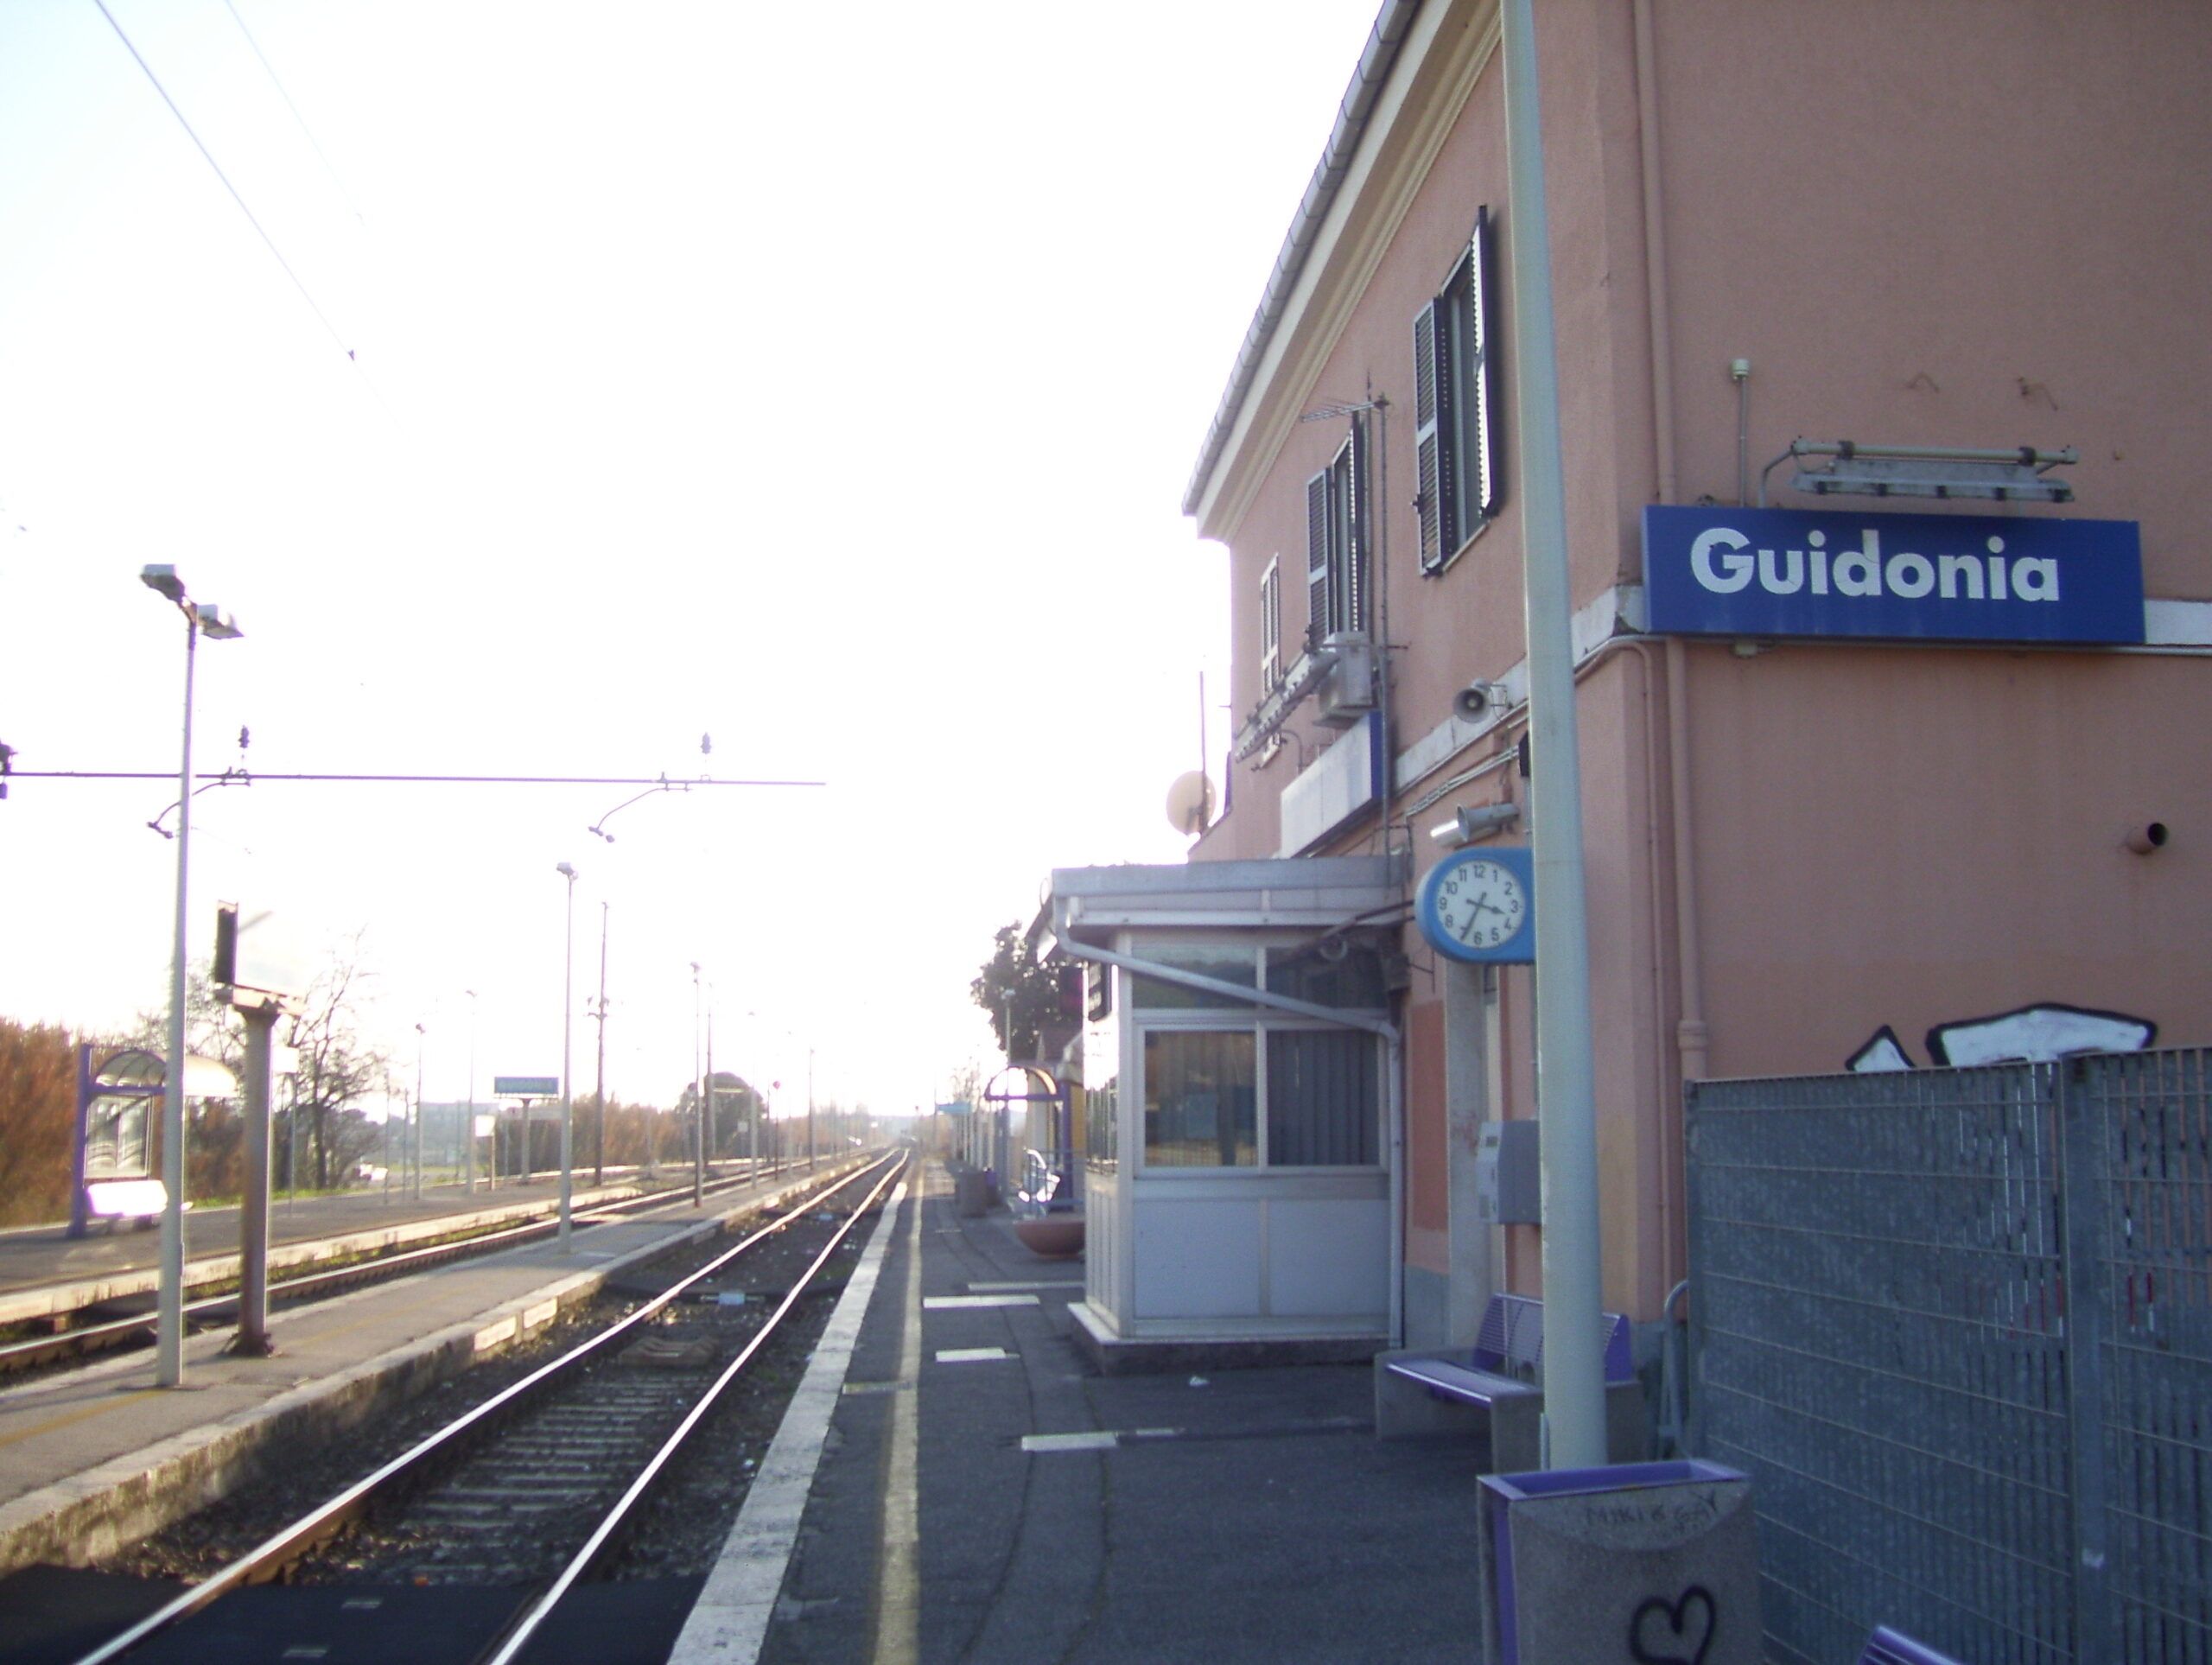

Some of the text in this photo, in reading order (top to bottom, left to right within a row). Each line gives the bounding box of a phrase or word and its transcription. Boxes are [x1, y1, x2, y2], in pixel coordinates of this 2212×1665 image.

[1690, 527, 2060, 602] Guidonia
[1458, 867, 1467, 881] 11
[1473, 864, 1486, 879] 12
[1492, 869, 1498, 882] 1
[1445, 881, 1459, 894] 10
[1504, 881, 1512, 895] 2
[1439, 897, 1447, 911] 9
[1510, 899, 1519, 913] 3
[1445, 914, 1453, 928] 8
[1504, 918, 1512, 931] 4
[1473, 931, 1483, 945] 6
[1491, 927, 1499, 942] 5
